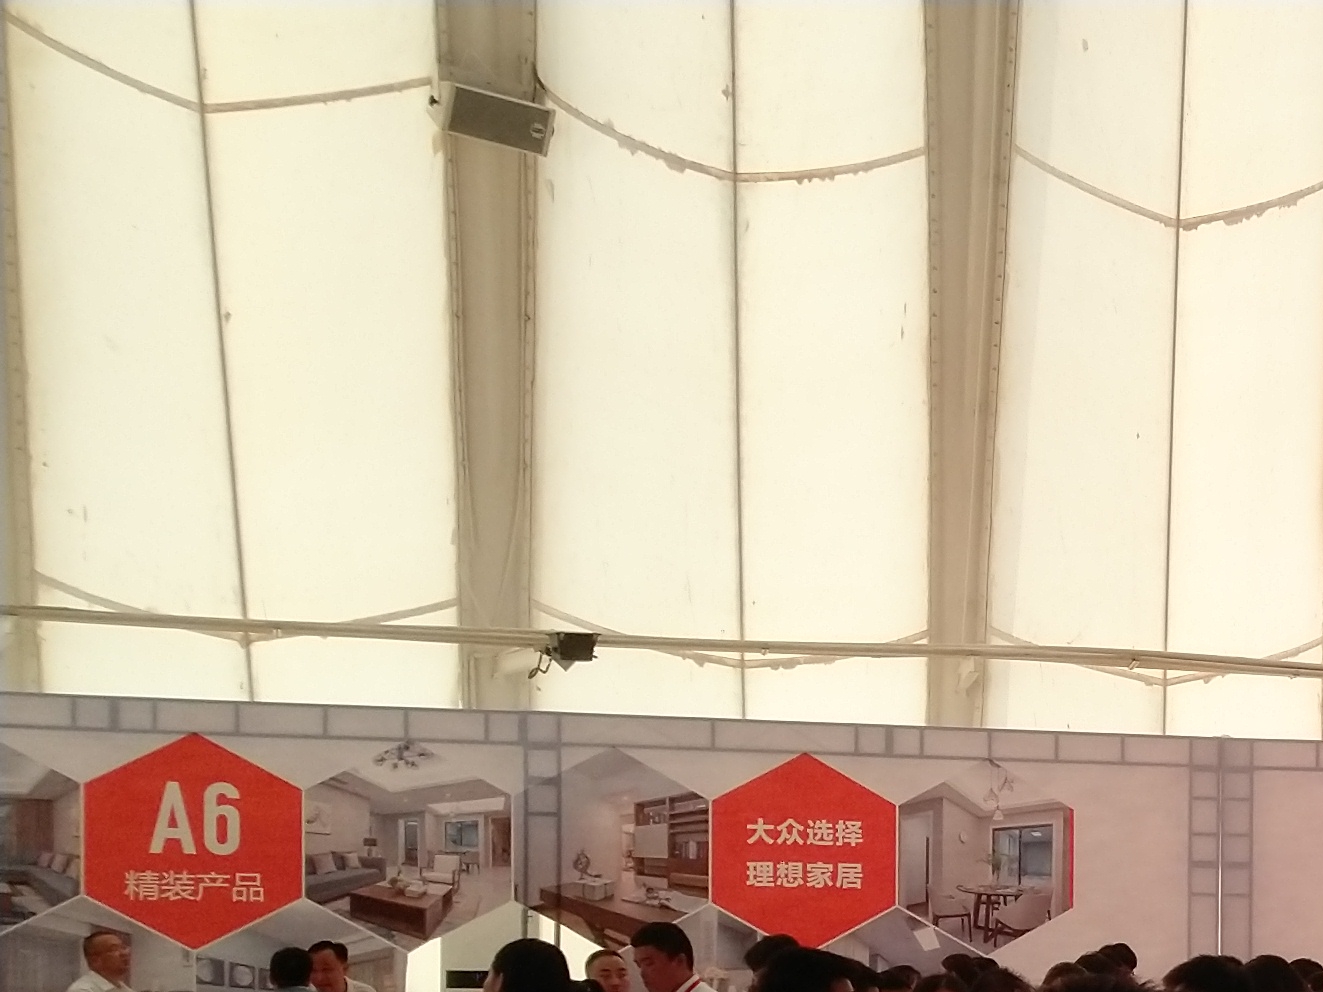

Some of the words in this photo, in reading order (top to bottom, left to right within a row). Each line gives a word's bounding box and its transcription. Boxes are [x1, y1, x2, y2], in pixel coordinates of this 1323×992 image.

[149, 781, 241, 856] A6
[746, 817, 864, 846] 大众选择
[124, 870, 265, 903] 精装产品
[746, 861, 864, 889] 理想家居
